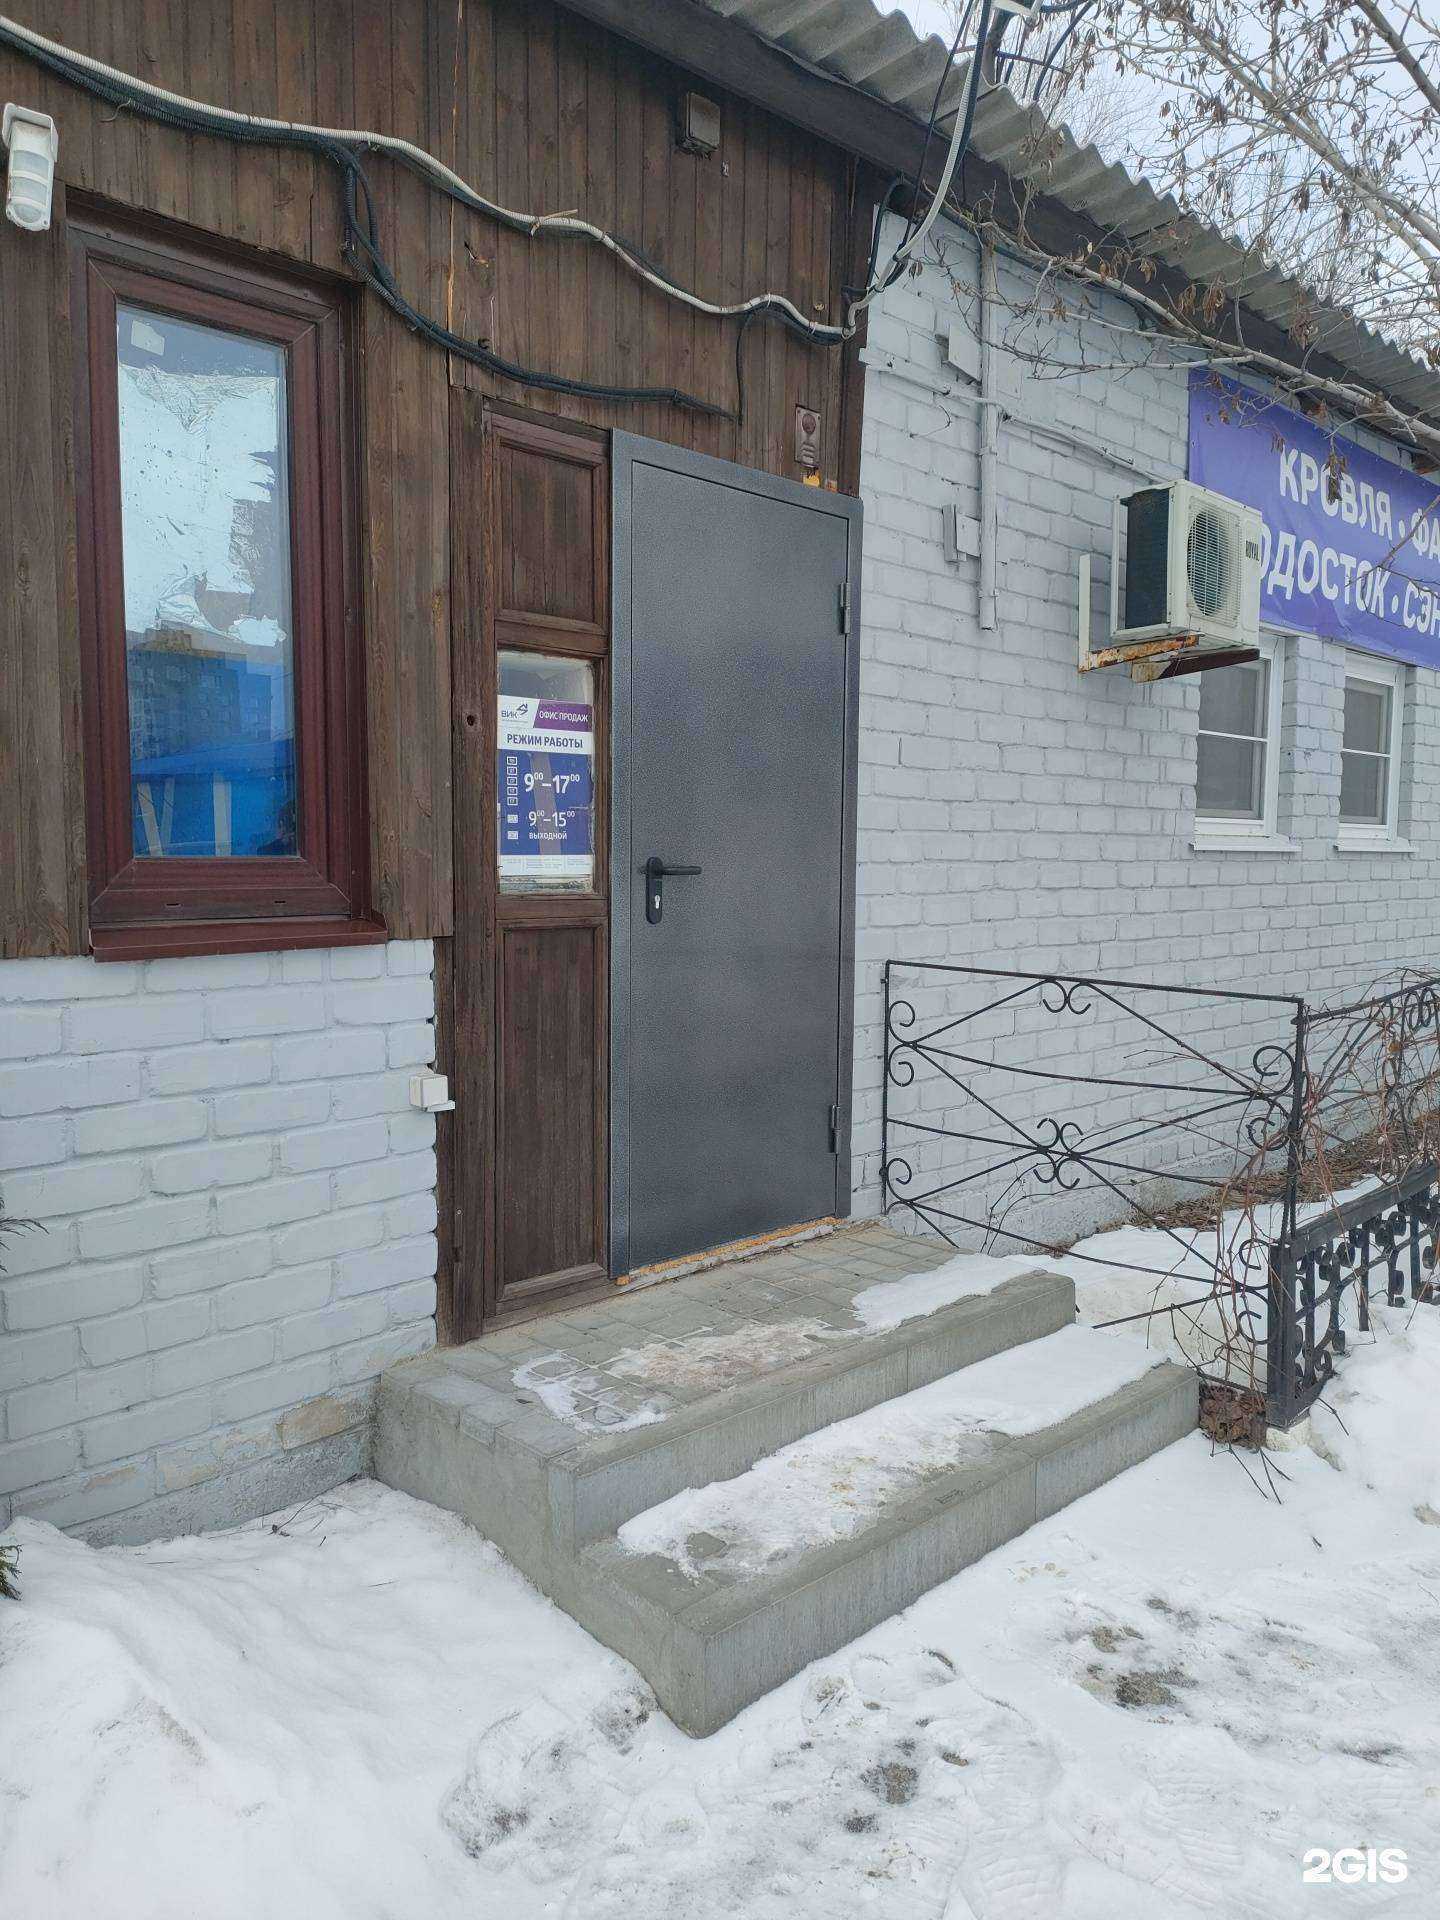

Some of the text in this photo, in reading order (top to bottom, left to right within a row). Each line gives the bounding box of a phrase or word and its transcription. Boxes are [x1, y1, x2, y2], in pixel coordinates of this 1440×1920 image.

[1280, 444, 1393, 541] КРОВЛЯ
[539, 710, 589, 723] ОФИС ПРОДАЖ
[507, 733, 583, 749] РЕЖИМ РАБОТЫ
